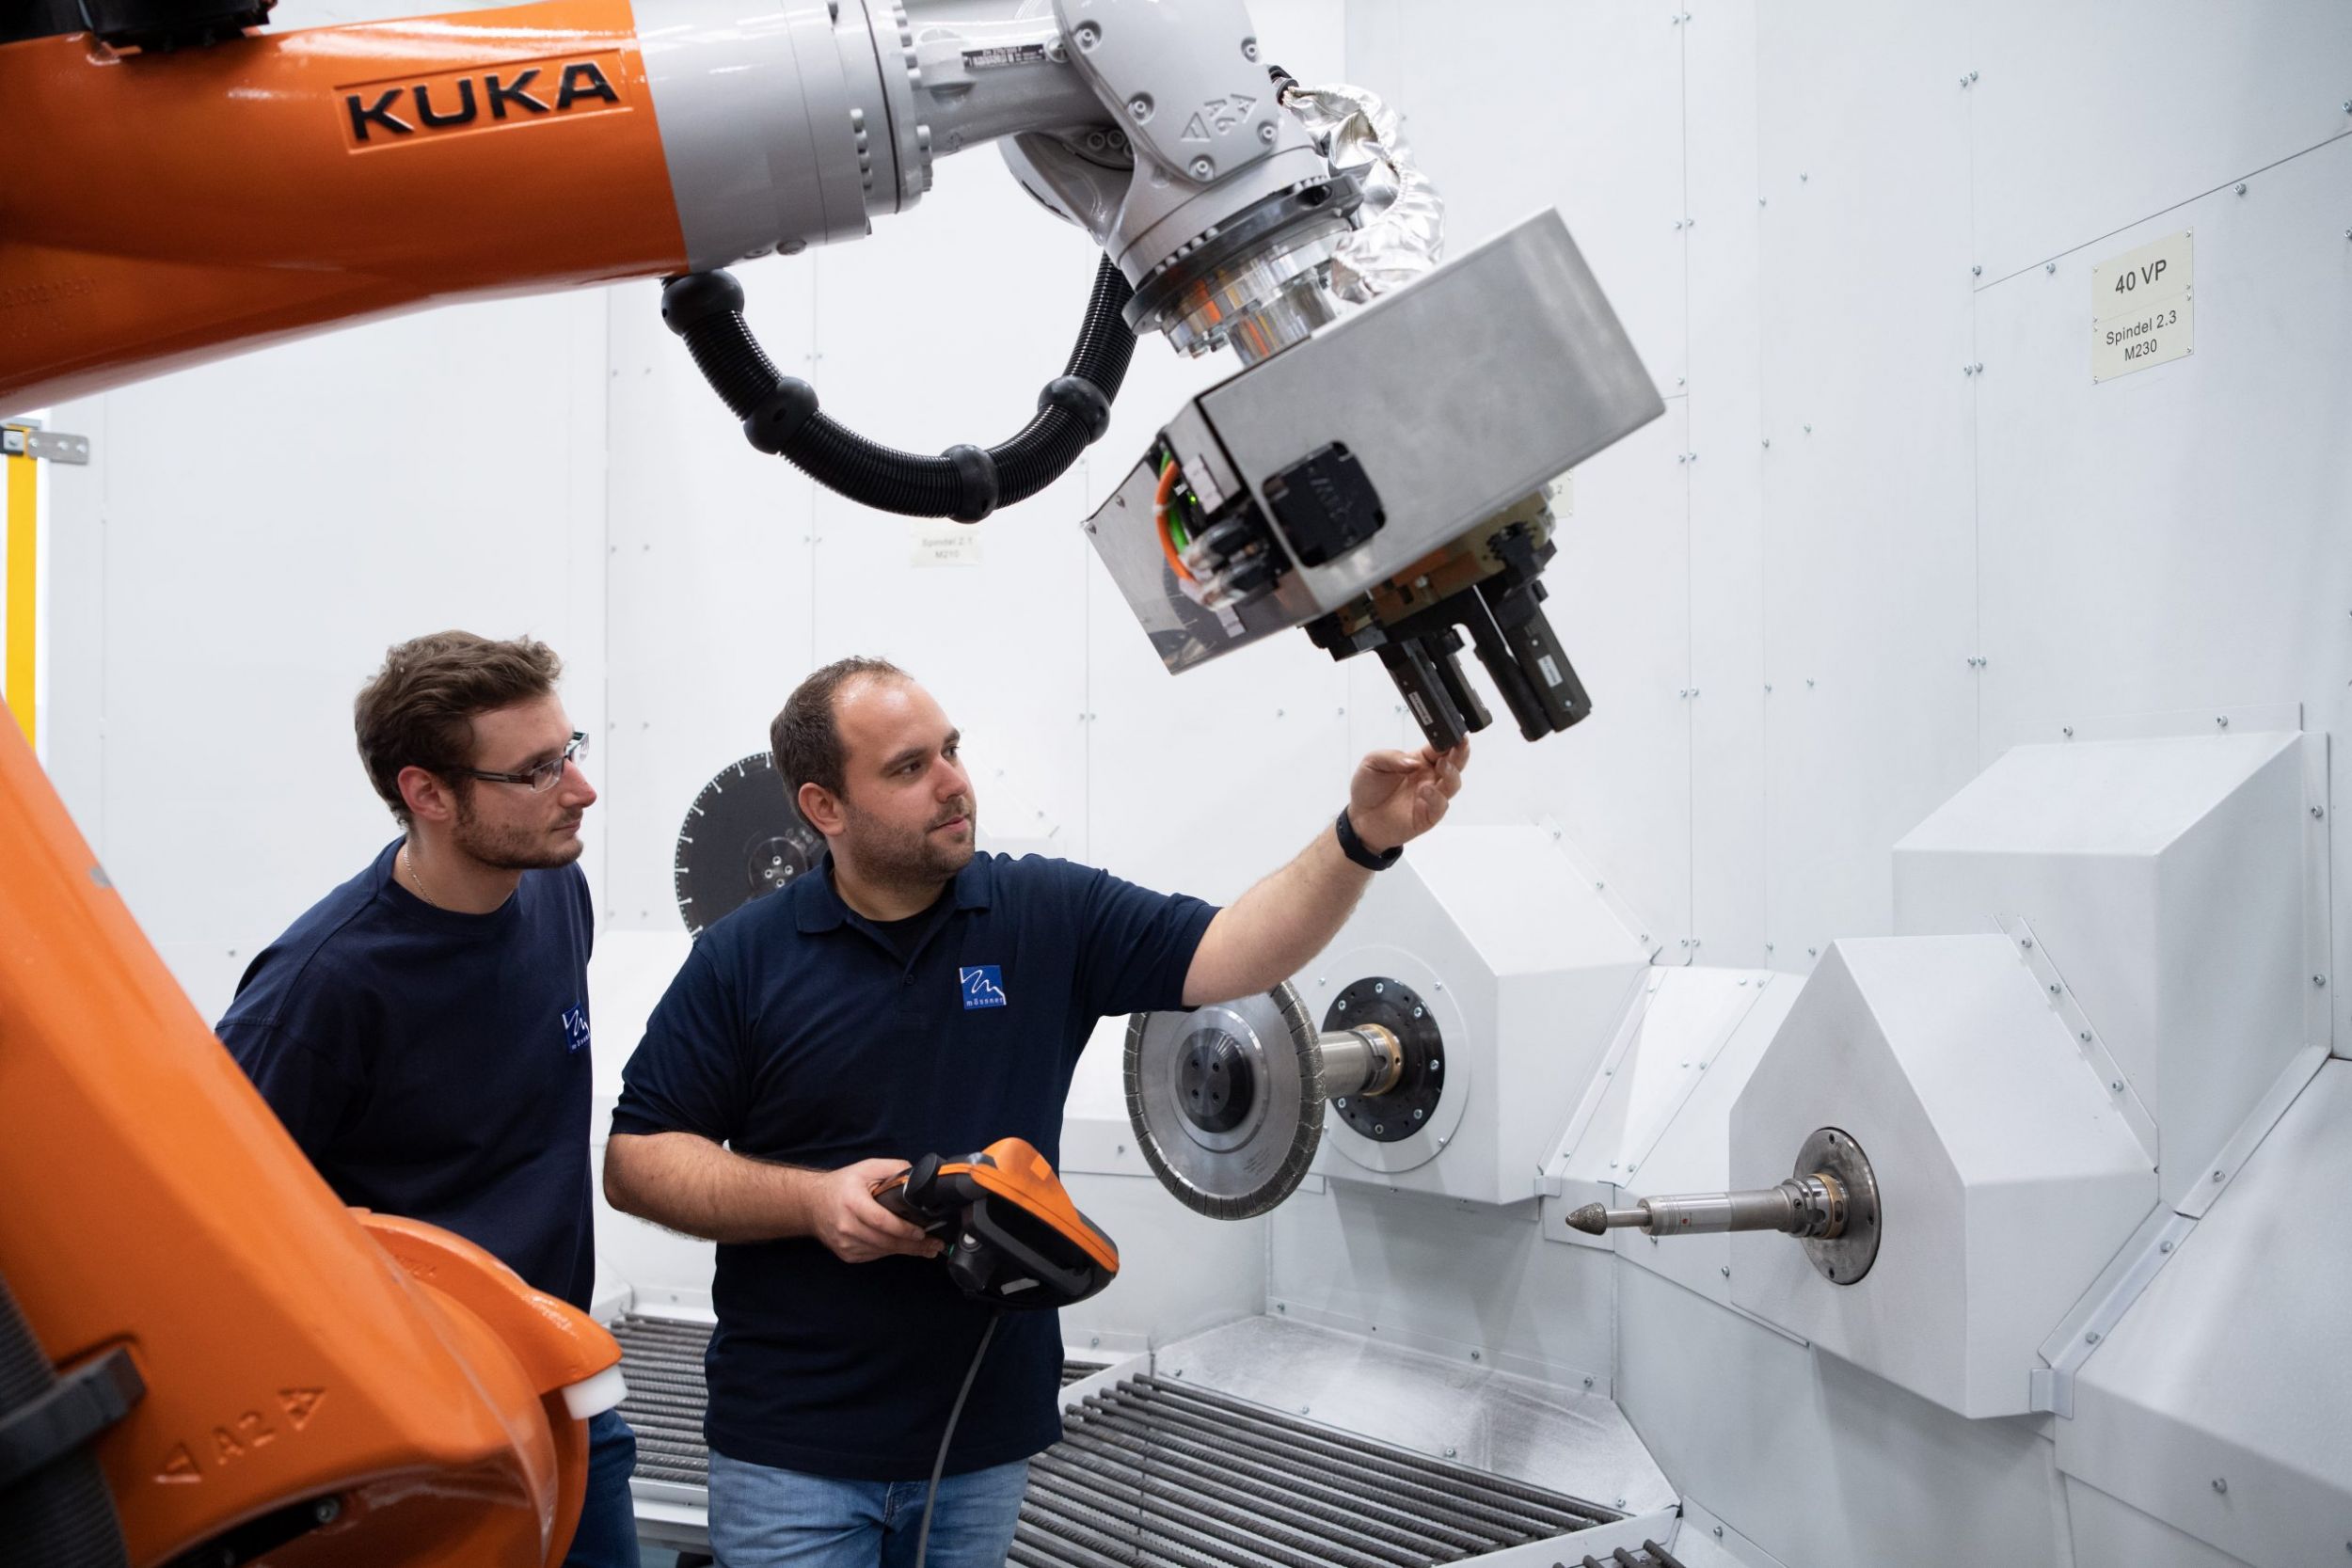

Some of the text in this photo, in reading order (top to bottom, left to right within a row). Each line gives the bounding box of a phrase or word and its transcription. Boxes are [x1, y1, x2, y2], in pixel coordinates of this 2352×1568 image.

[346, 59, 620, 141] KUKA
[2115, 259, 2167, 293] 40 VP
[2106, 309, 2177, 345] Spindel 2.3
[2124, 339, 2157, 361] M230
